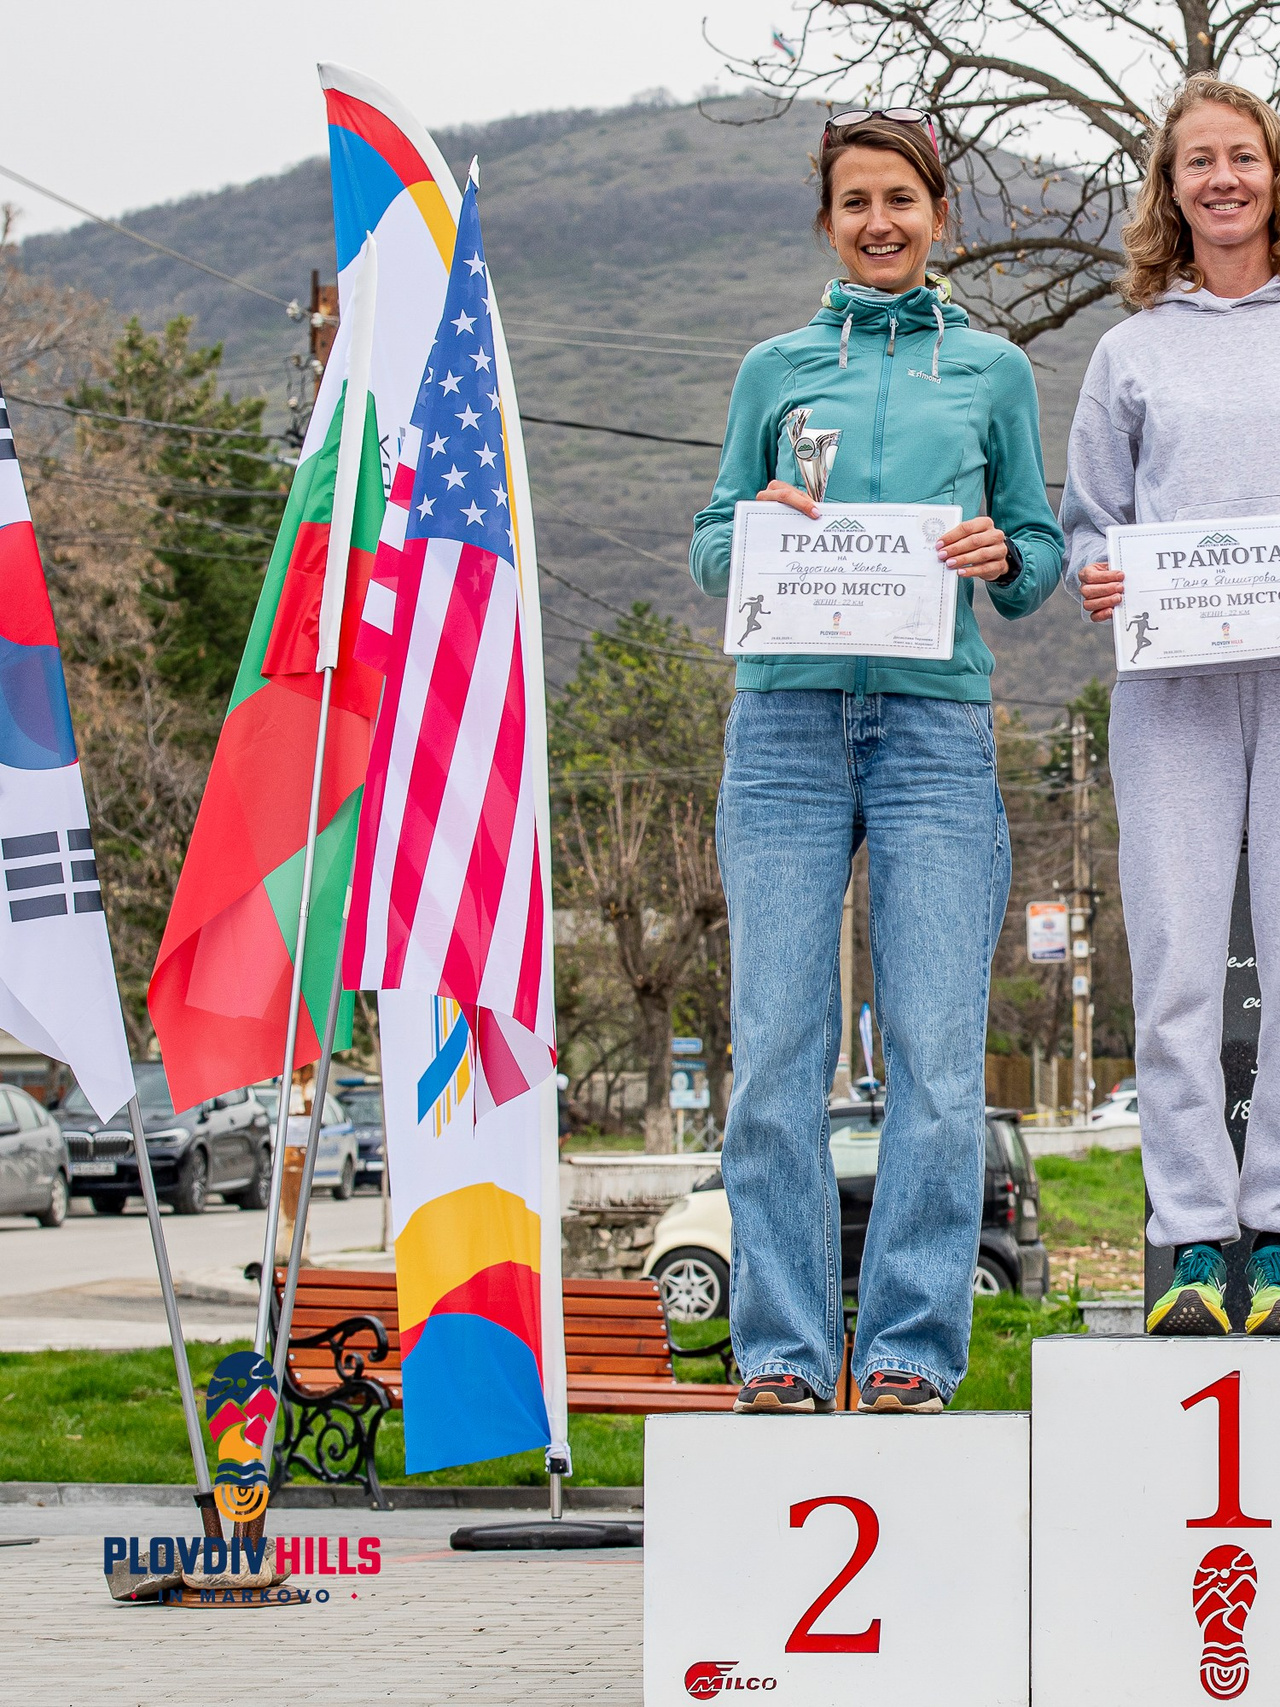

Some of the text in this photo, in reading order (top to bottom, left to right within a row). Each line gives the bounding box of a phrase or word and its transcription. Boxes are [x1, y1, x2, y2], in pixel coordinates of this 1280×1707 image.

[916, 370, 942, 384] simond
[780, 533, 911, 554] ГРАМОТА
[777, 582, 906, 597] ВТОРО МЯСТО
[1160, 594, 1222, 611] ПЪРВО
[1230, 1100, 1250, 1120] 18
[1180, 1370, 1272, 1529] 1
[785, 1495, 881, 1654] 2
[689, 1676, 778, 1691] MILCO
